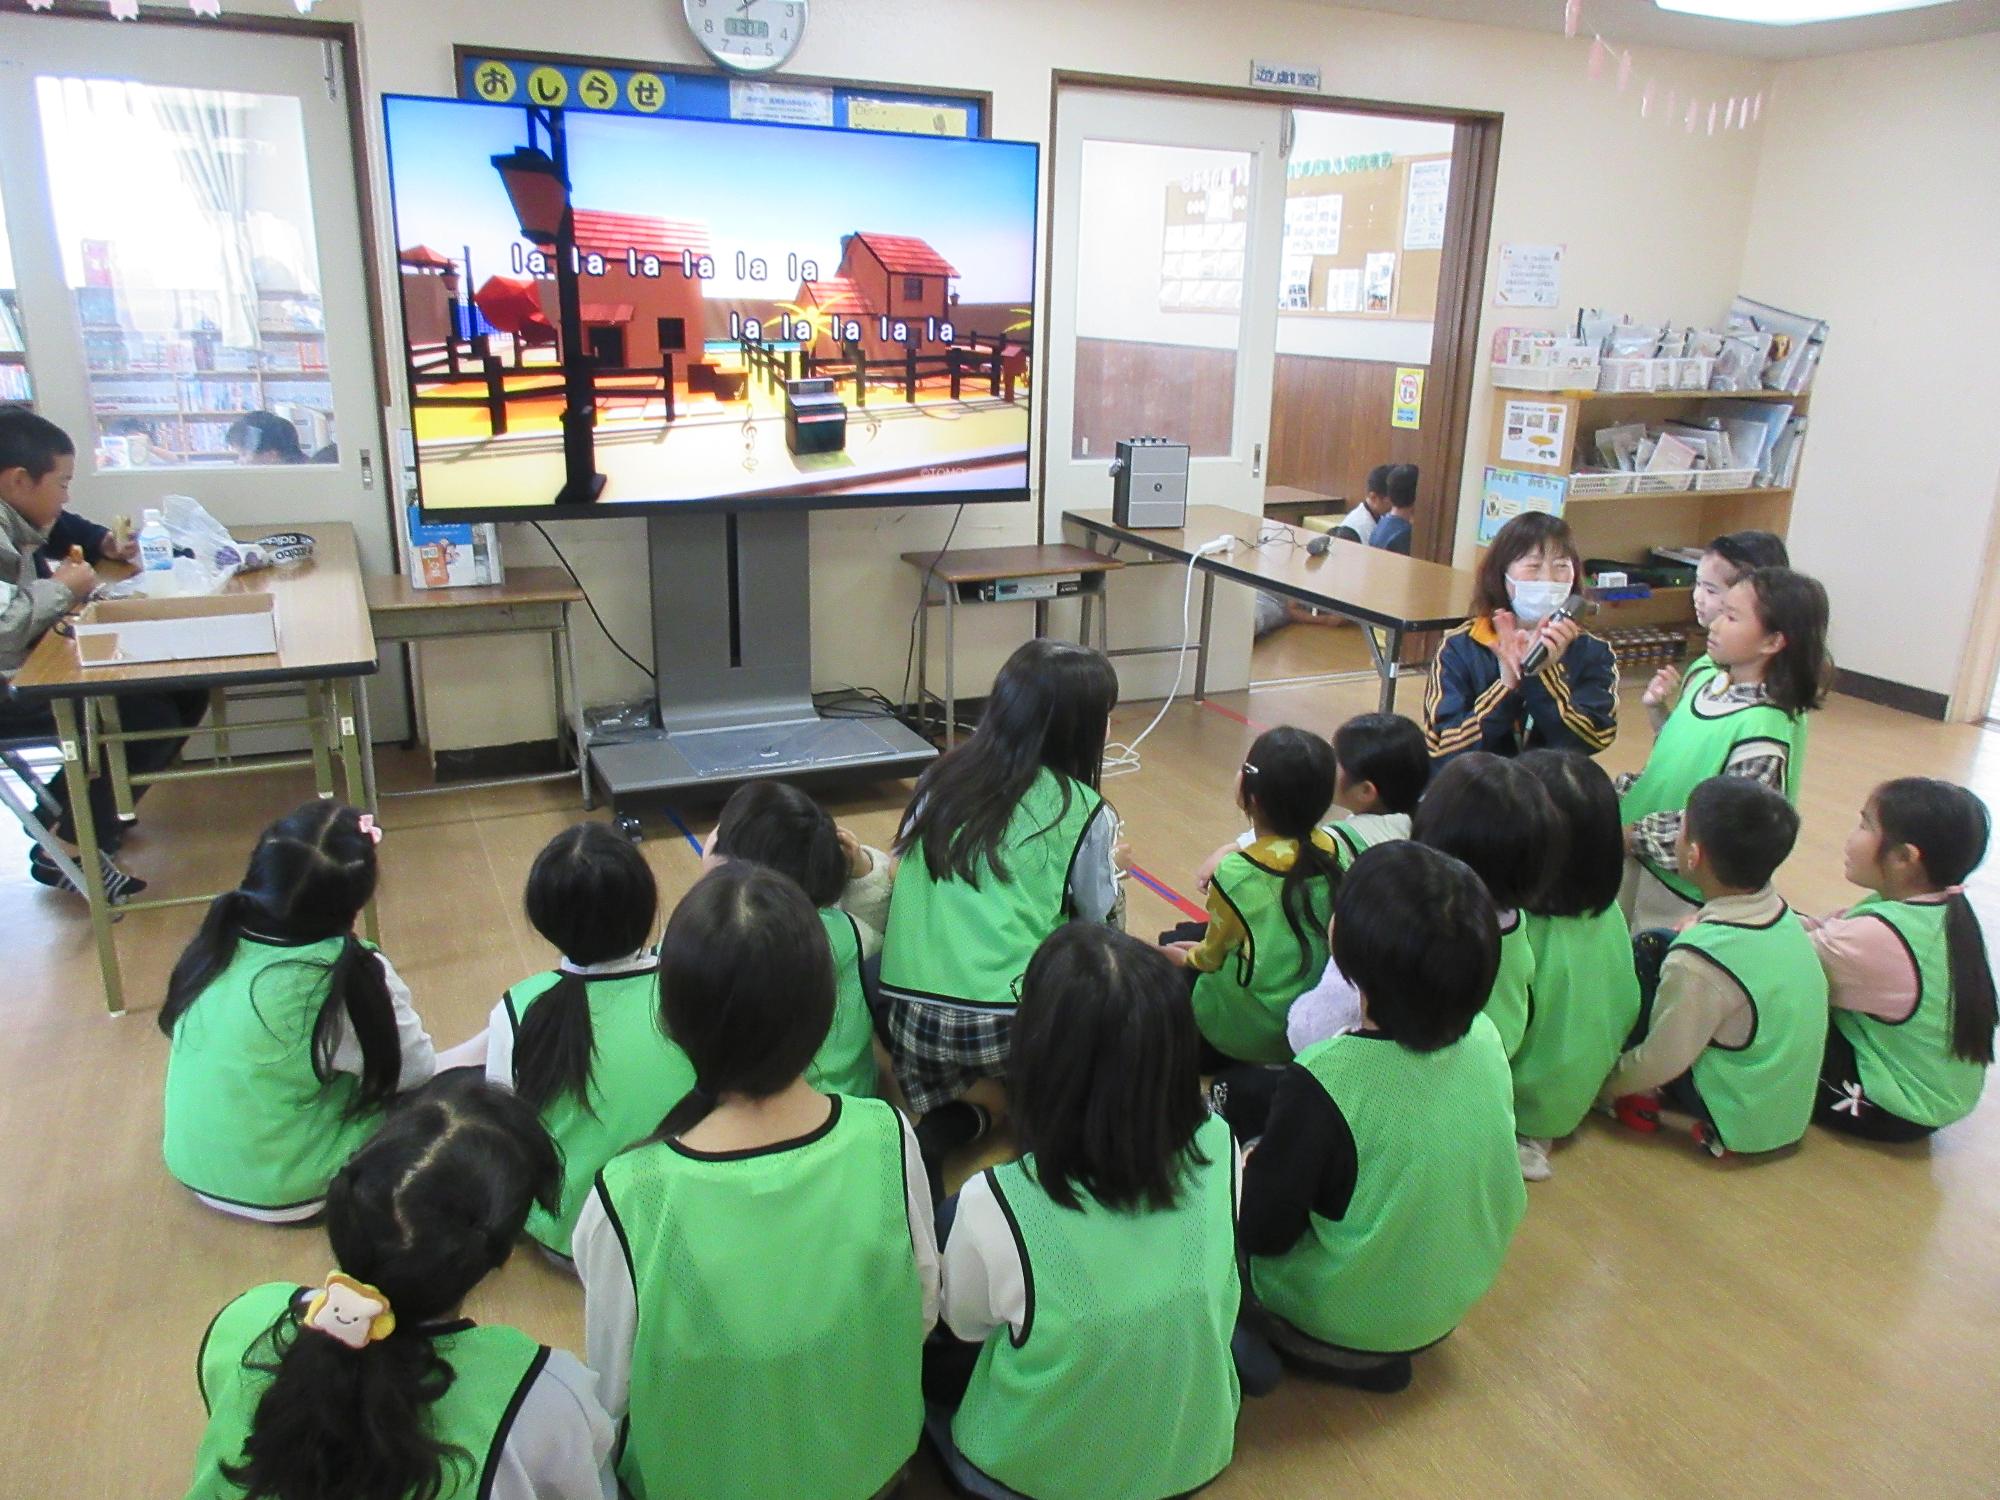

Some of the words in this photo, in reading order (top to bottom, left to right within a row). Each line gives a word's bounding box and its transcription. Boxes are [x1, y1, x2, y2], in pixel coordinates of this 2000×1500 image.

[785, 4, 794, 17] 3
[704, 20, 714, 33] 8
[780, 28, 788, 40] 4
[721, 38, 730, 52] 7
[742, 46, 751, 57] 6
[764, 43, 774, 57] 5
[482, 67, 658, 107] おしらせ
[511, 242, 547, 275] la
[571, 245, 606, 277] la
[626, 247, 661, 279] la
[682, 249, 715, 280] la
[736, 251, 767, 281] la
[788, 252, 819, 282] la
[730, 311, 762, 341] la
[781, 311, 812, 341] la
[831, 313, 861, 341] la
[880, 314, 908, 342] la
[928, 315, 954, 342] la
